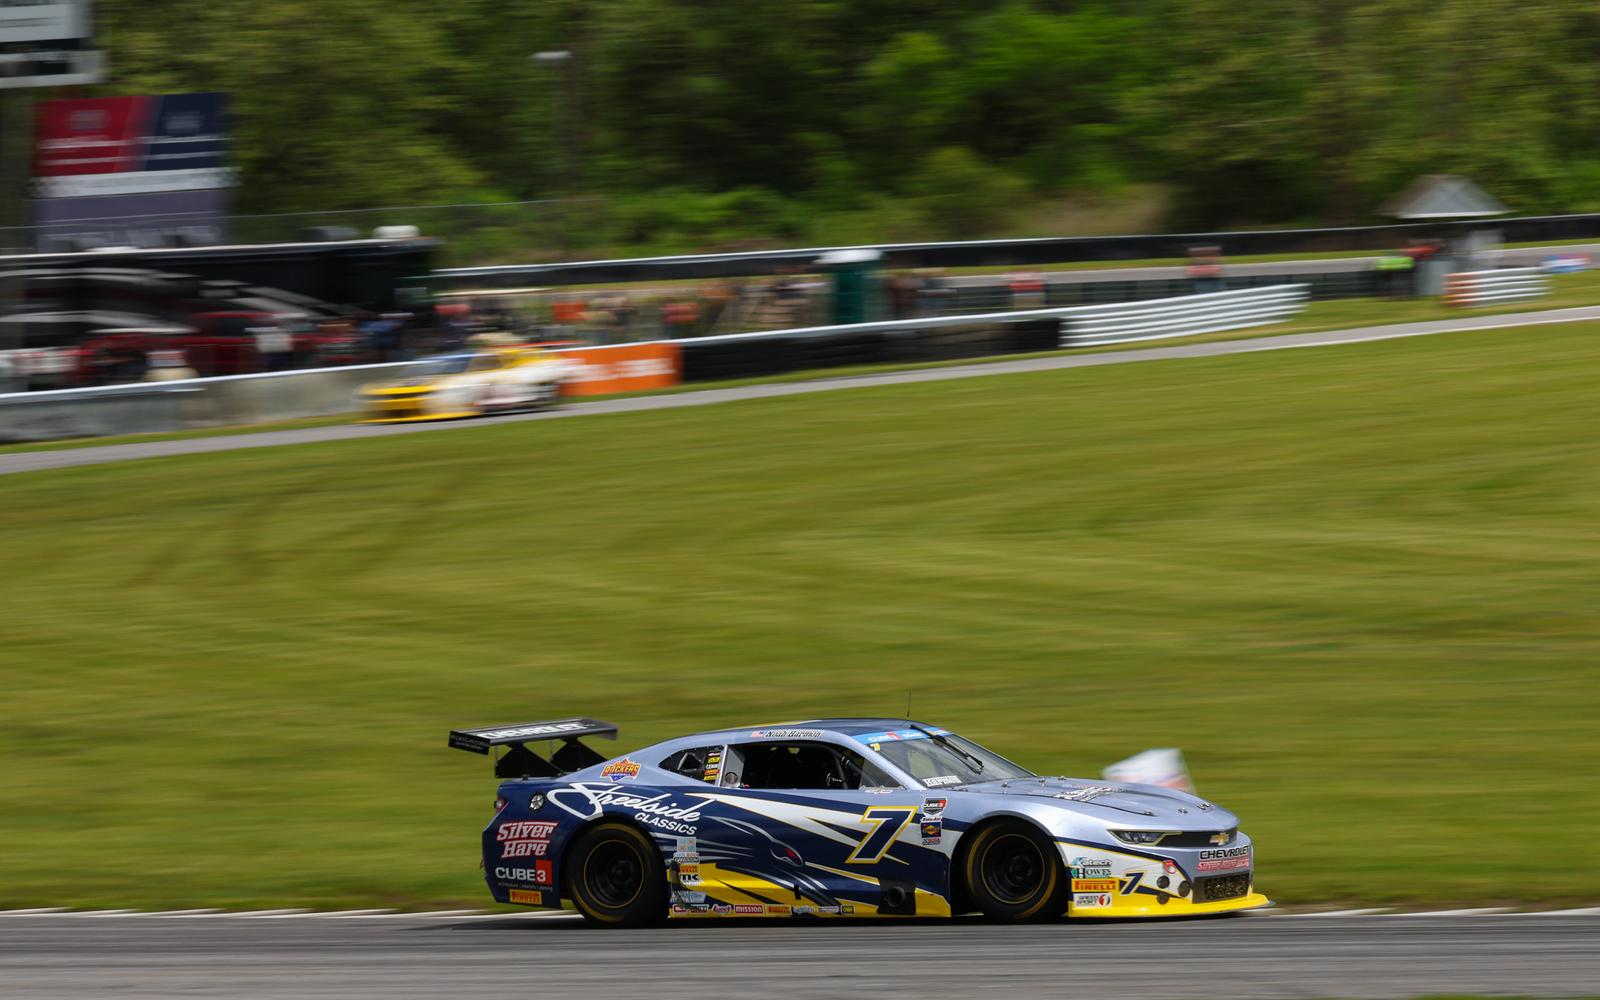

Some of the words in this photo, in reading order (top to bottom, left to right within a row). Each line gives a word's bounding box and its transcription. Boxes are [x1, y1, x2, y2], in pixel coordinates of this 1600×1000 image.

[547, 782, 716, 822] Streetside
[496, 821, 558, 841] Silver
[634, 812, 697, 836] CLASSICS
[845, 806, 918, 864] 7
[501, 840, 550, 859] Hare
[1200, 846, 1249, 860] CHEVROLET
[495, 867, 546, 882] CUBE3
[1120, 870, 1146, 896] 7
[1074, 880, 1116, 890] PIRELLI
[511, 891, 540, 903] PIRELLI
